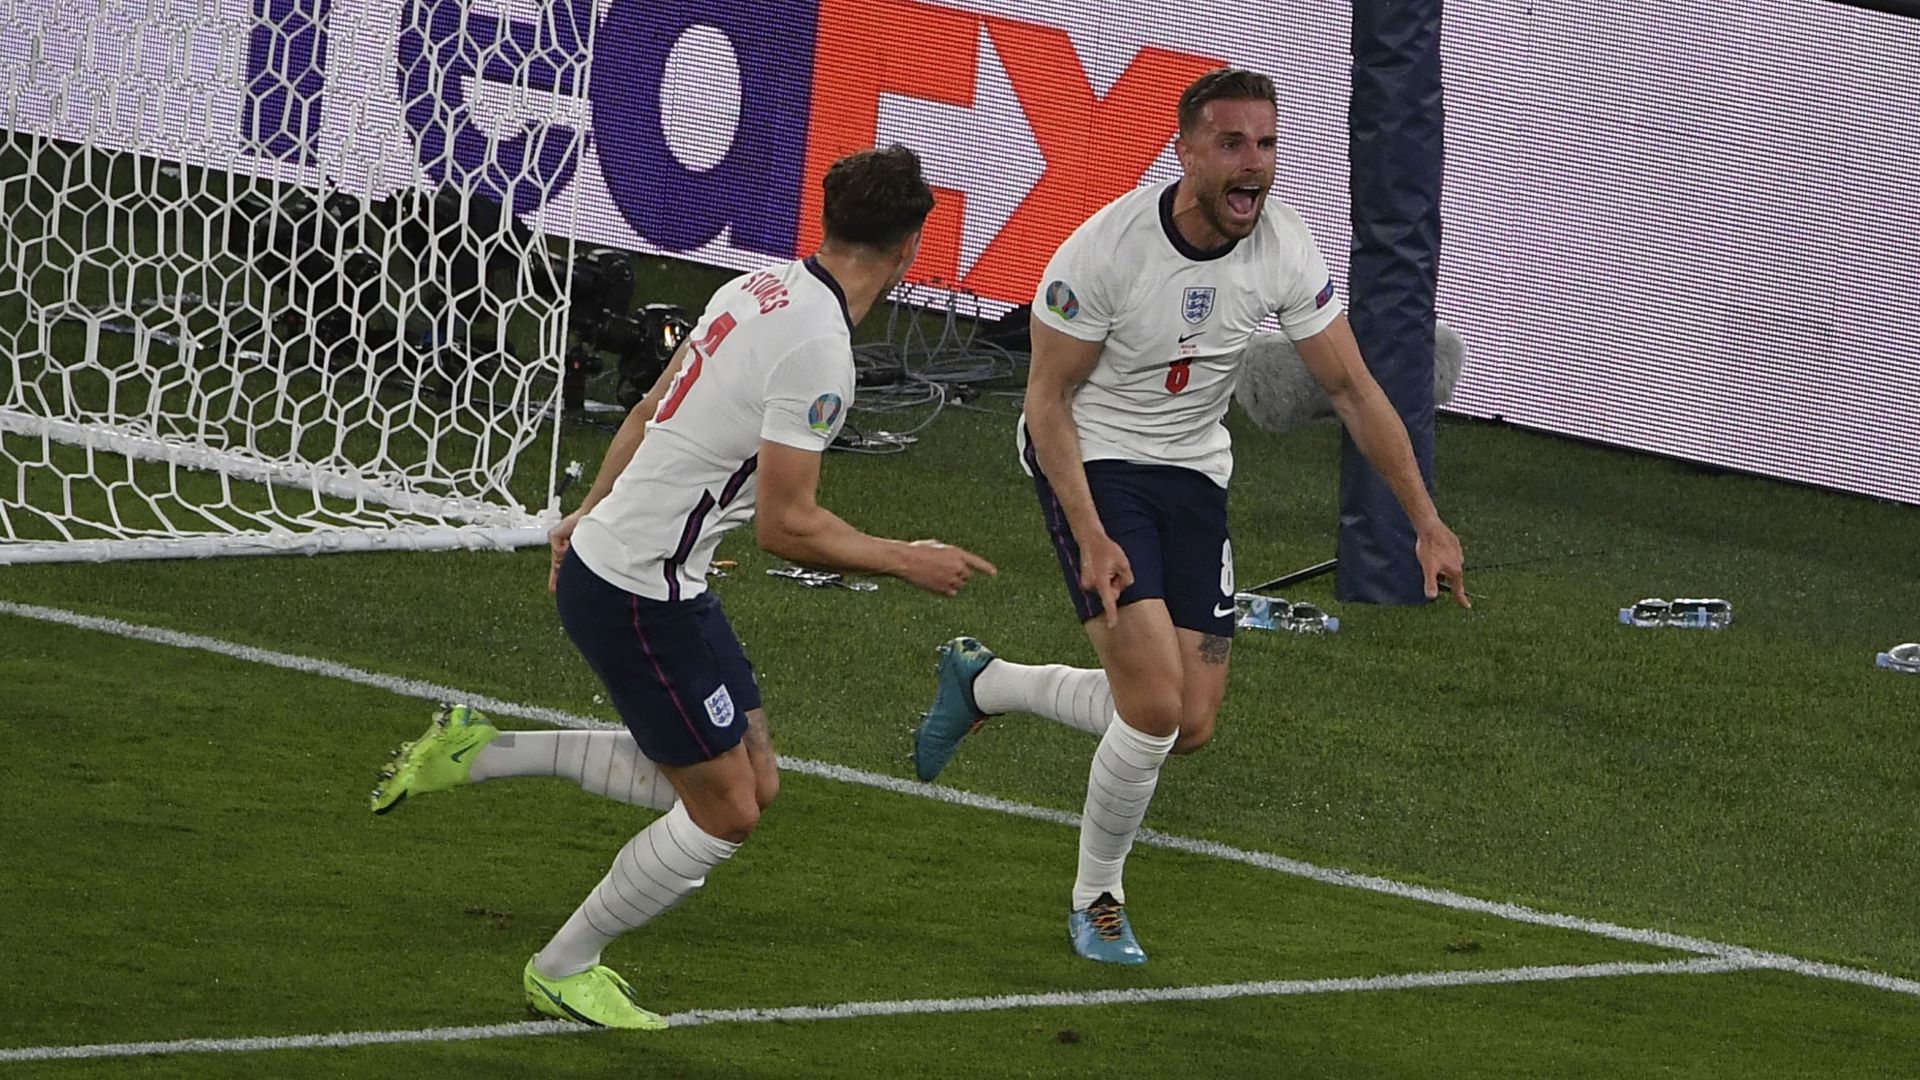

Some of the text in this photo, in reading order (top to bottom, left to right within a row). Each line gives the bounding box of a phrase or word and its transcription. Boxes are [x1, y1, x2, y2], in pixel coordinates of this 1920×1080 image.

[740, 271, 790, 315] STONES
[655, 311, 738, 424] 5
[1164, 357, 1193, 395] 8
[1219, 538, 1235, 597] 8
